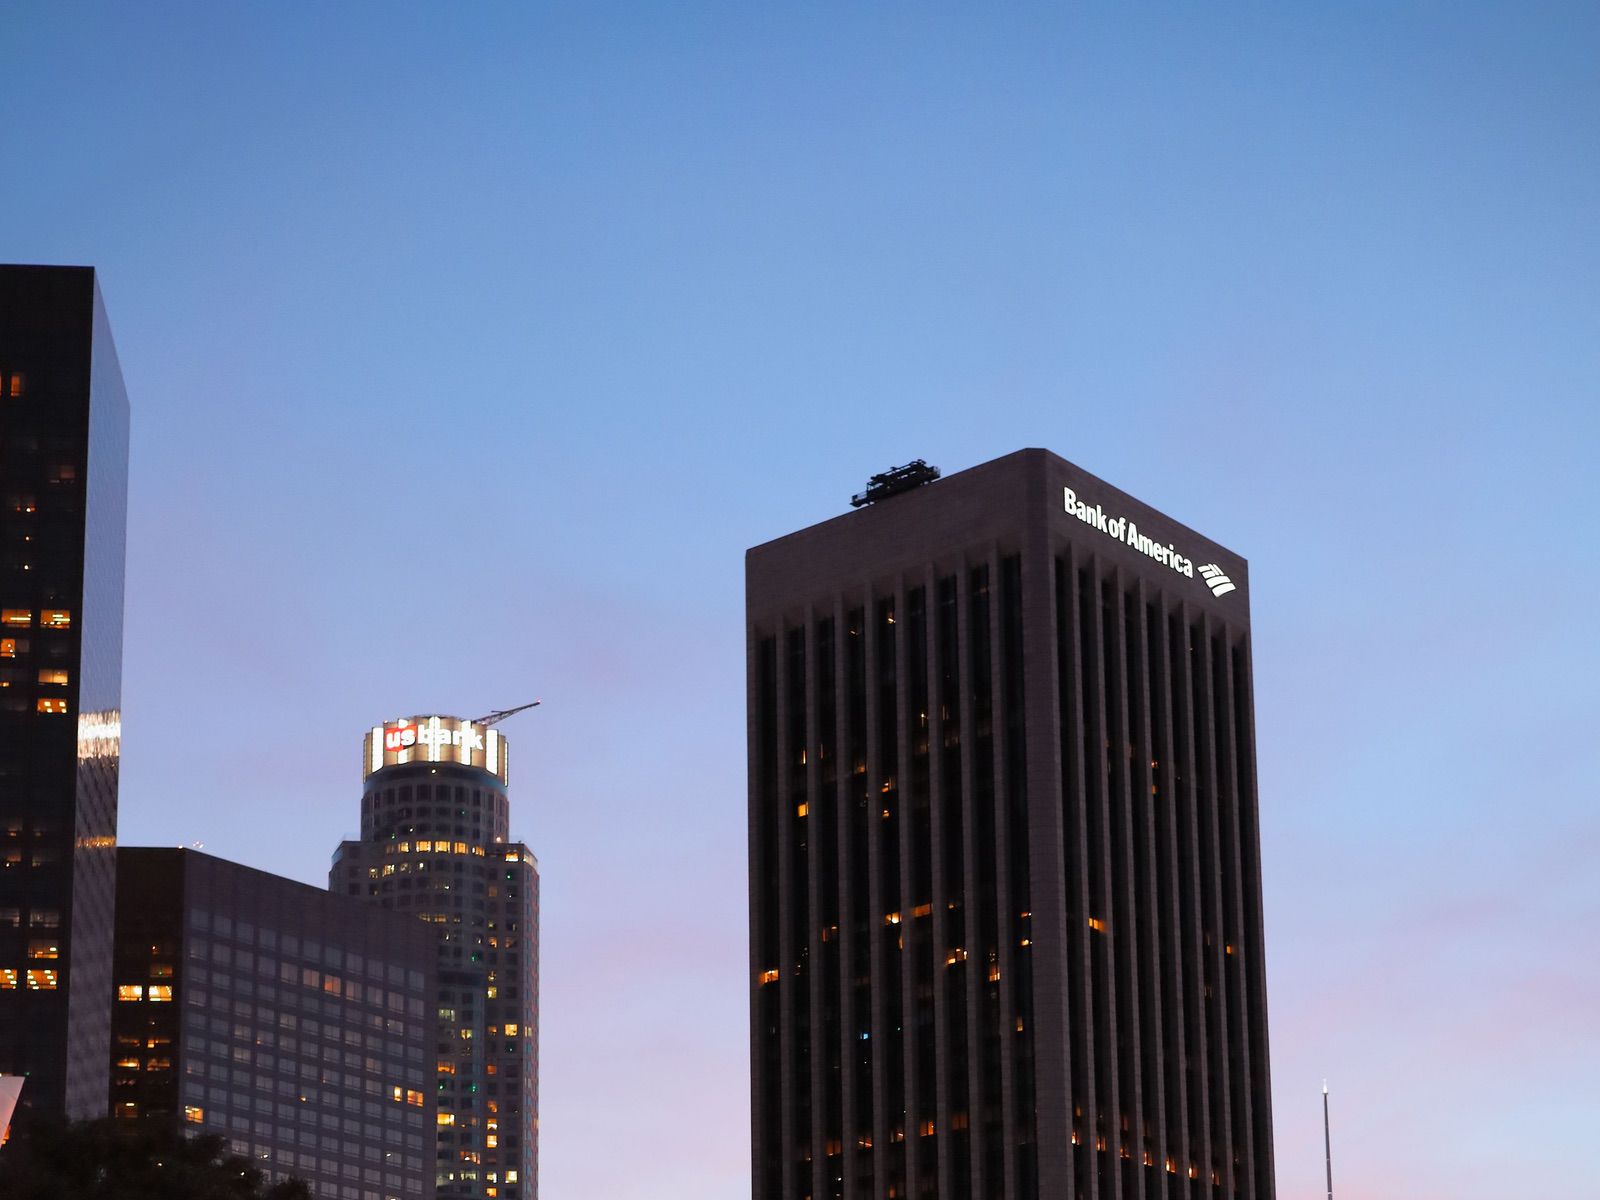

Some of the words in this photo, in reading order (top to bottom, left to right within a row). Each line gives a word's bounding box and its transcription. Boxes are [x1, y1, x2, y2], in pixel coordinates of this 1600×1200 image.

[1063, 486, 1108, 533] Bank
[1108, 516, 1126, 542] of
[1127, 522, 1193, 579] America
[417, 724, 484, 750] bank
